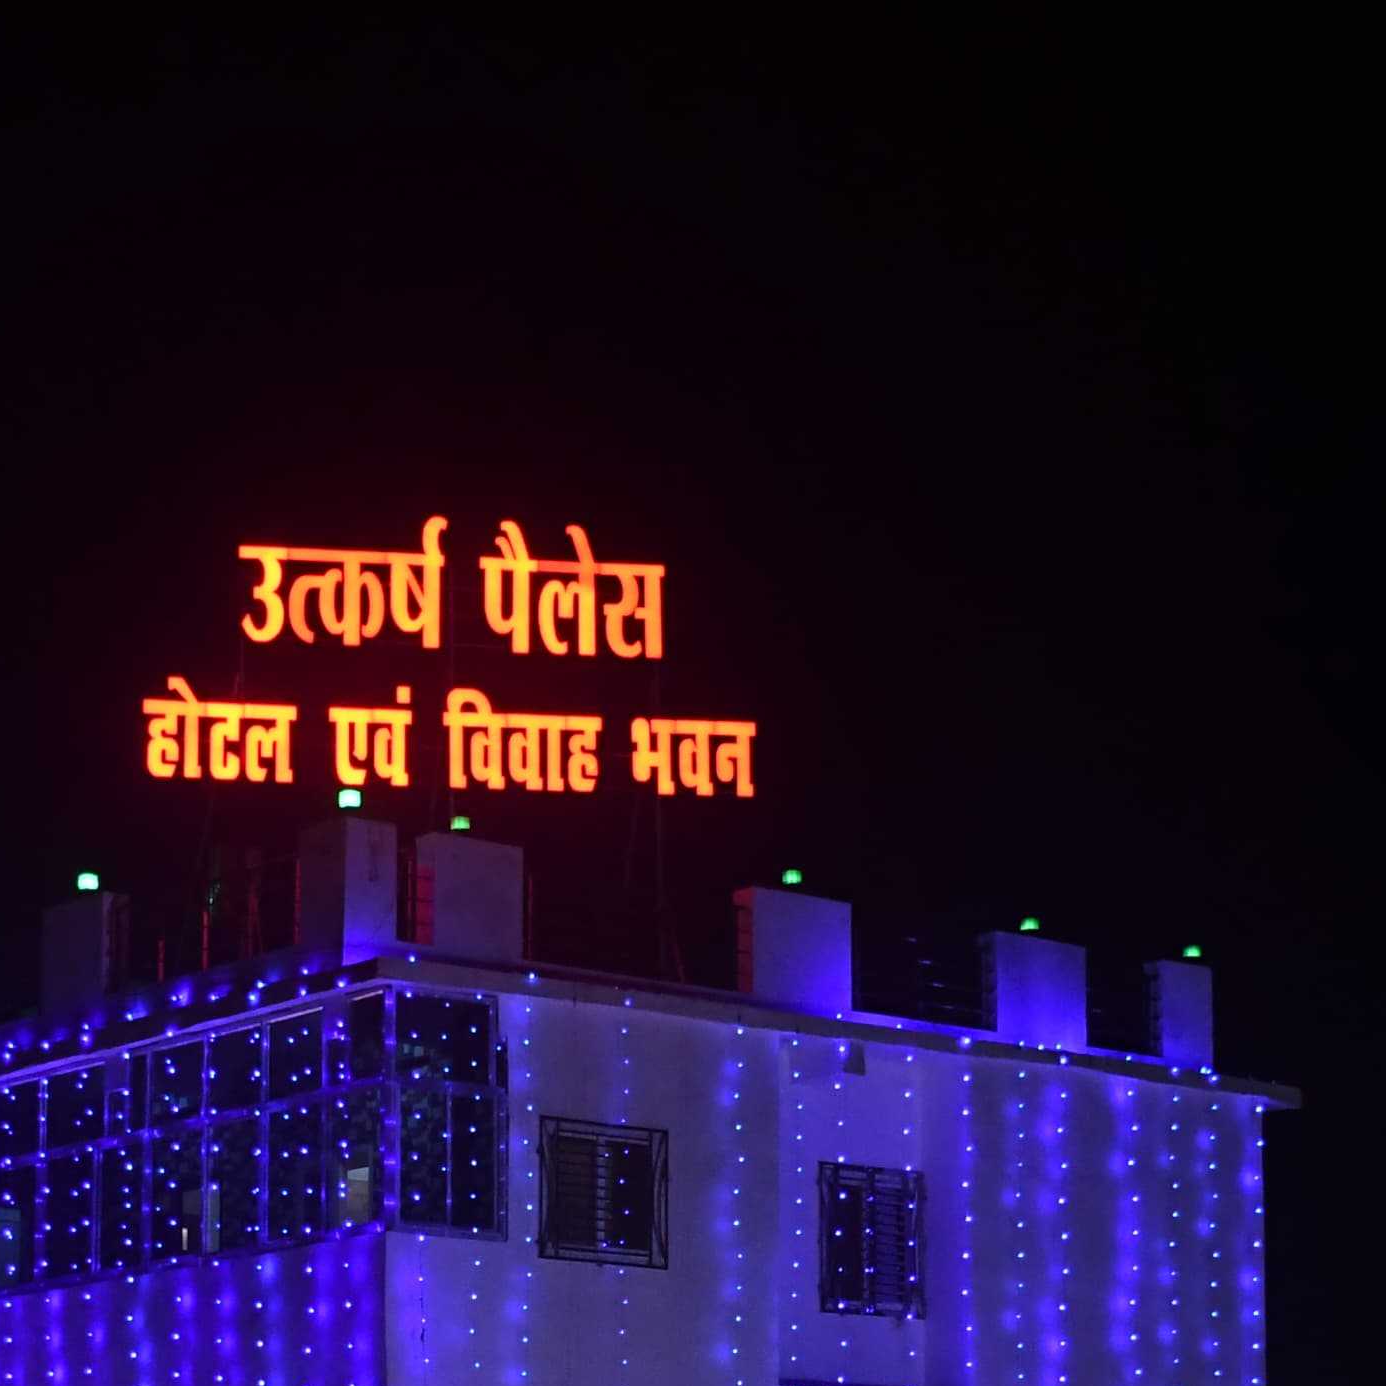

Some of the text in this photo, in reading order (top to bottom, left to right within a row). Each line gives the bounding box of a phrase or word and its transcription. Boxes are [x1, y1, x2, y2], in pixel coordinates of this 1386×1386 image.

[237, 514, 667, 661] उत्कर्ष पैलेस
[141, 674, 758, 799] होटल एवं विवाह भवन
